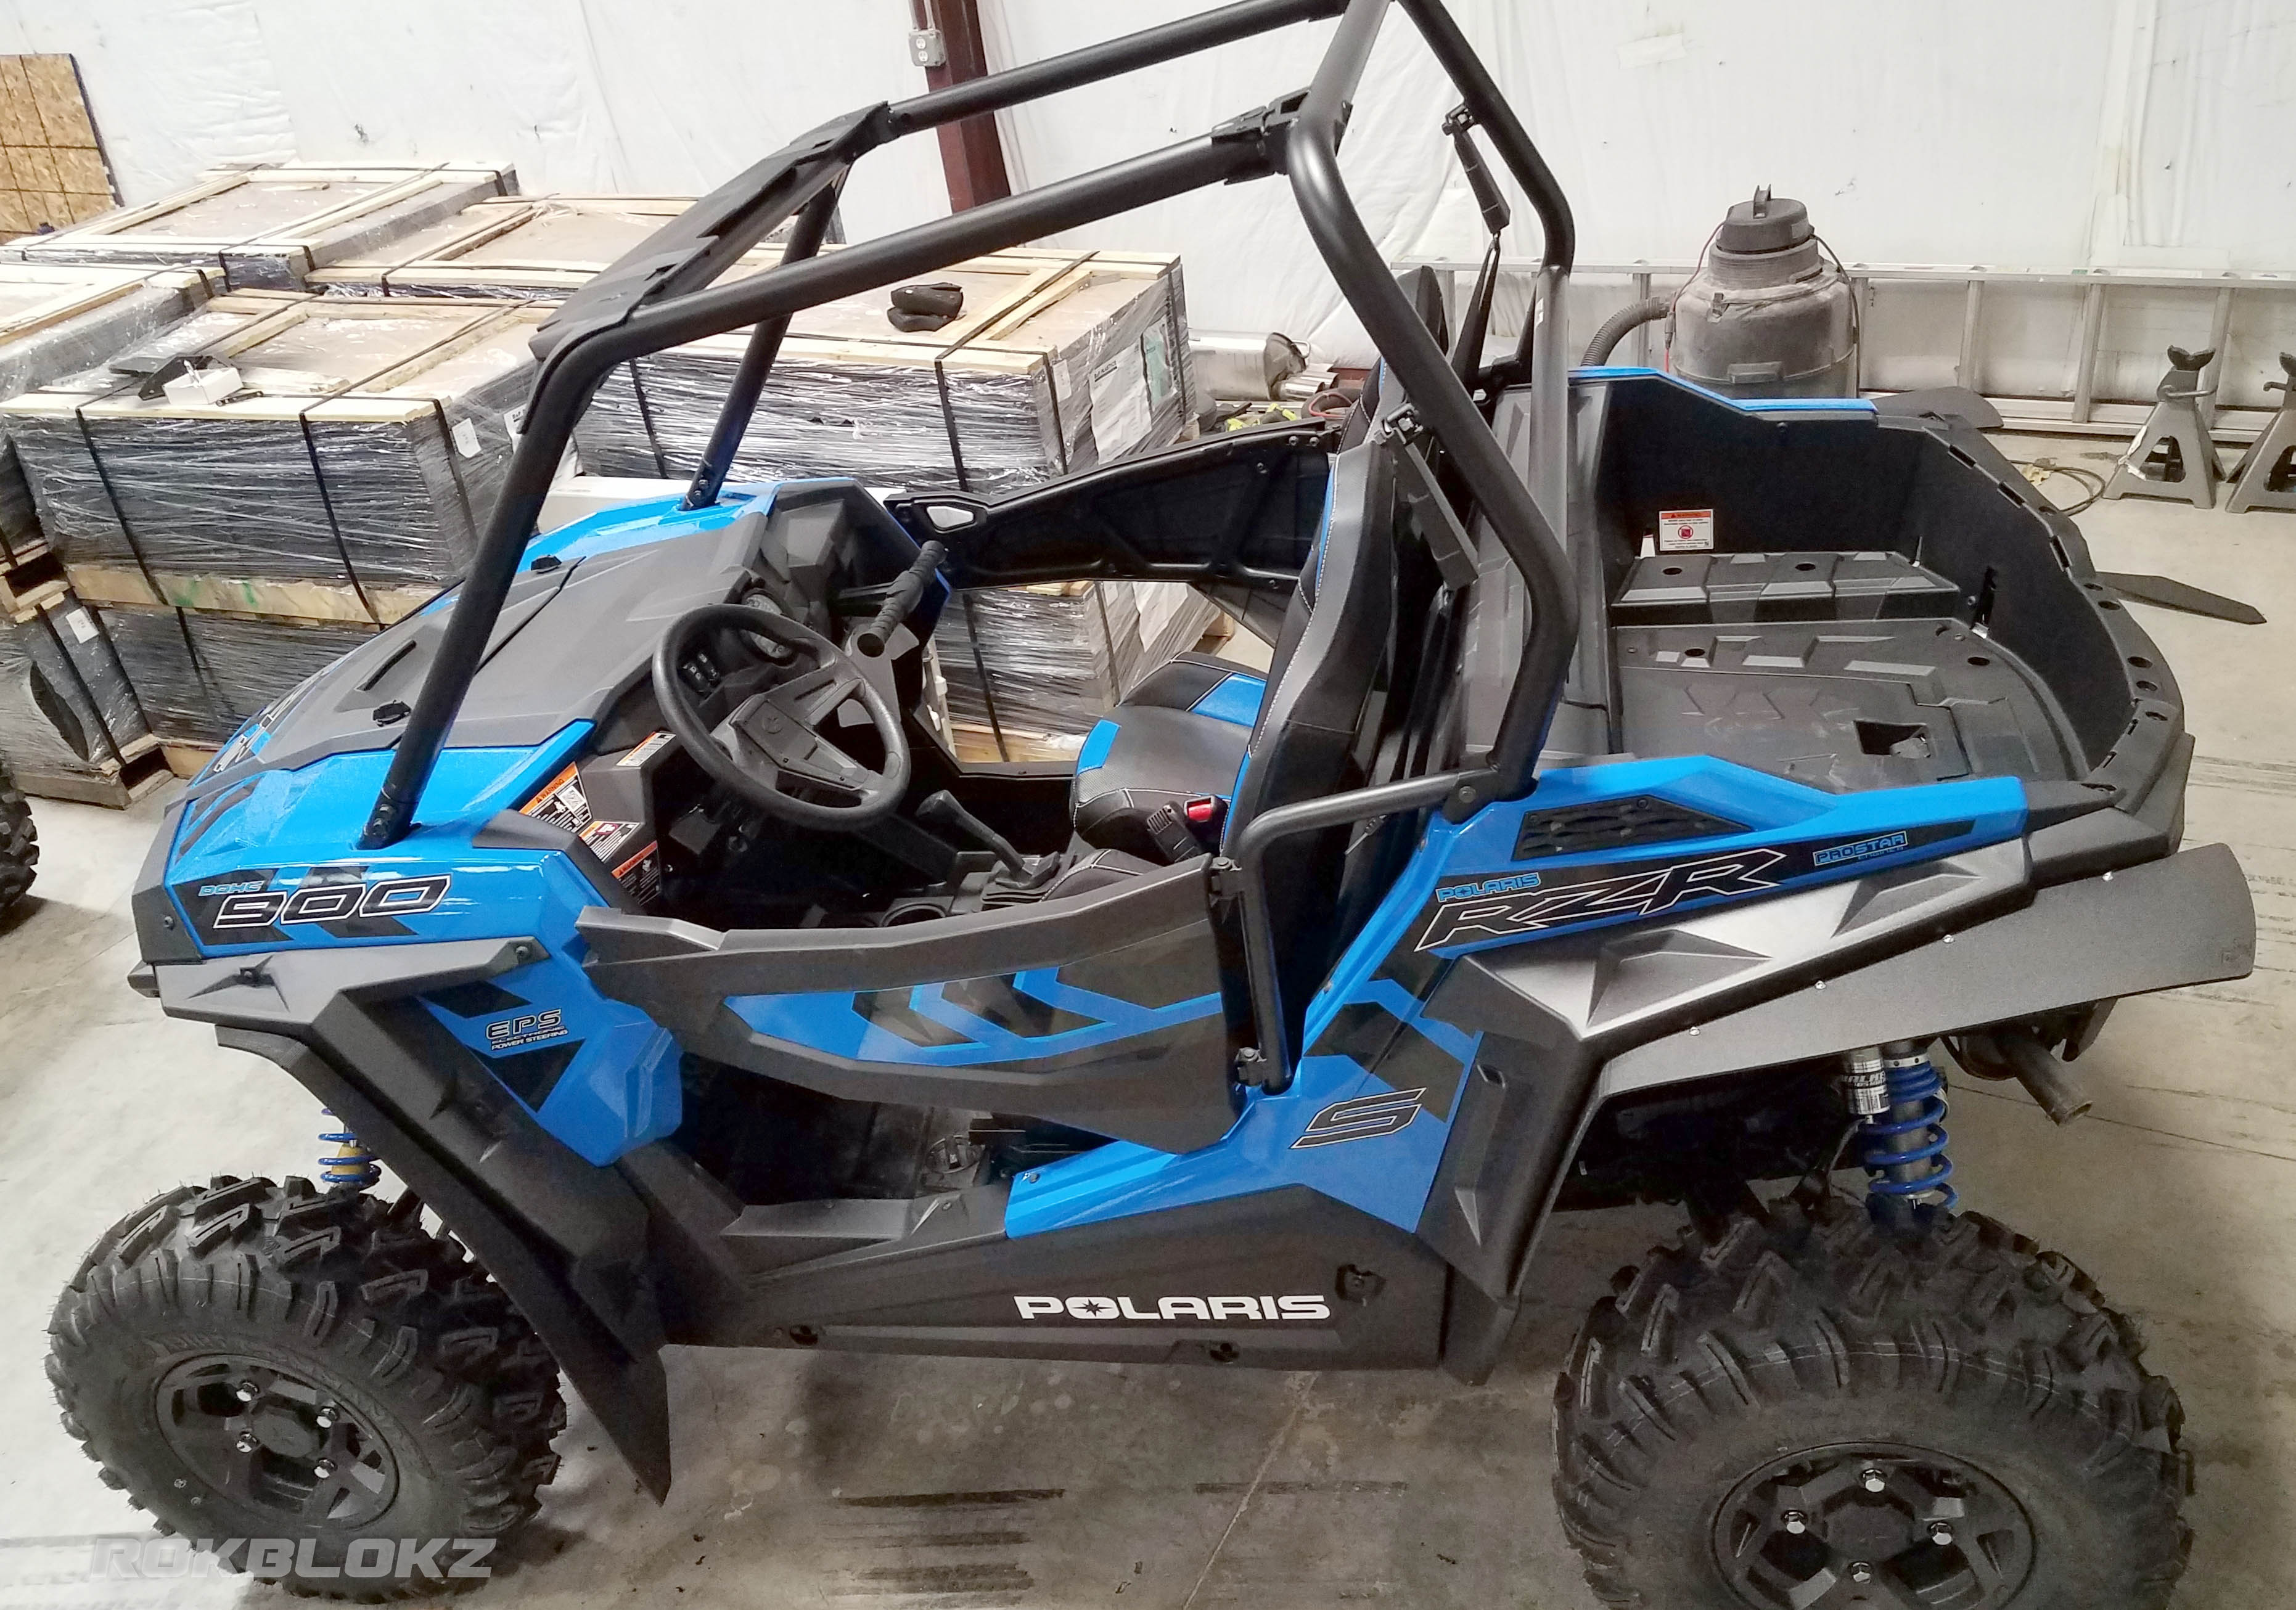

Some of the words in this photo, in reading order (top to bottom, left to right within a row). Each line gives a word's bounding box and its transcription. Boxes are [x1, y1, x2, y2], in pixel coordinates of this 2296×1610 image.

[1816, 835, 1904, 863] PROSTAR
[198, 881, 265, 896] DOHC
[213, 875, 451, 929] 900
[1414, 848, 1787, 952] RZR
[1436, 872, 1541, 903] POLARIS
[486, 1008, 562, 1040] EPS
[492, 1026, 565, 1044] ELECTRONIC
[491, 1039, 524, 1050] POWER
[525, 1029, 568, 1043] STEERING
[1289, 1087, 1427, 1150] S
[1013, 1294, 1331, 1320] POLARIS
